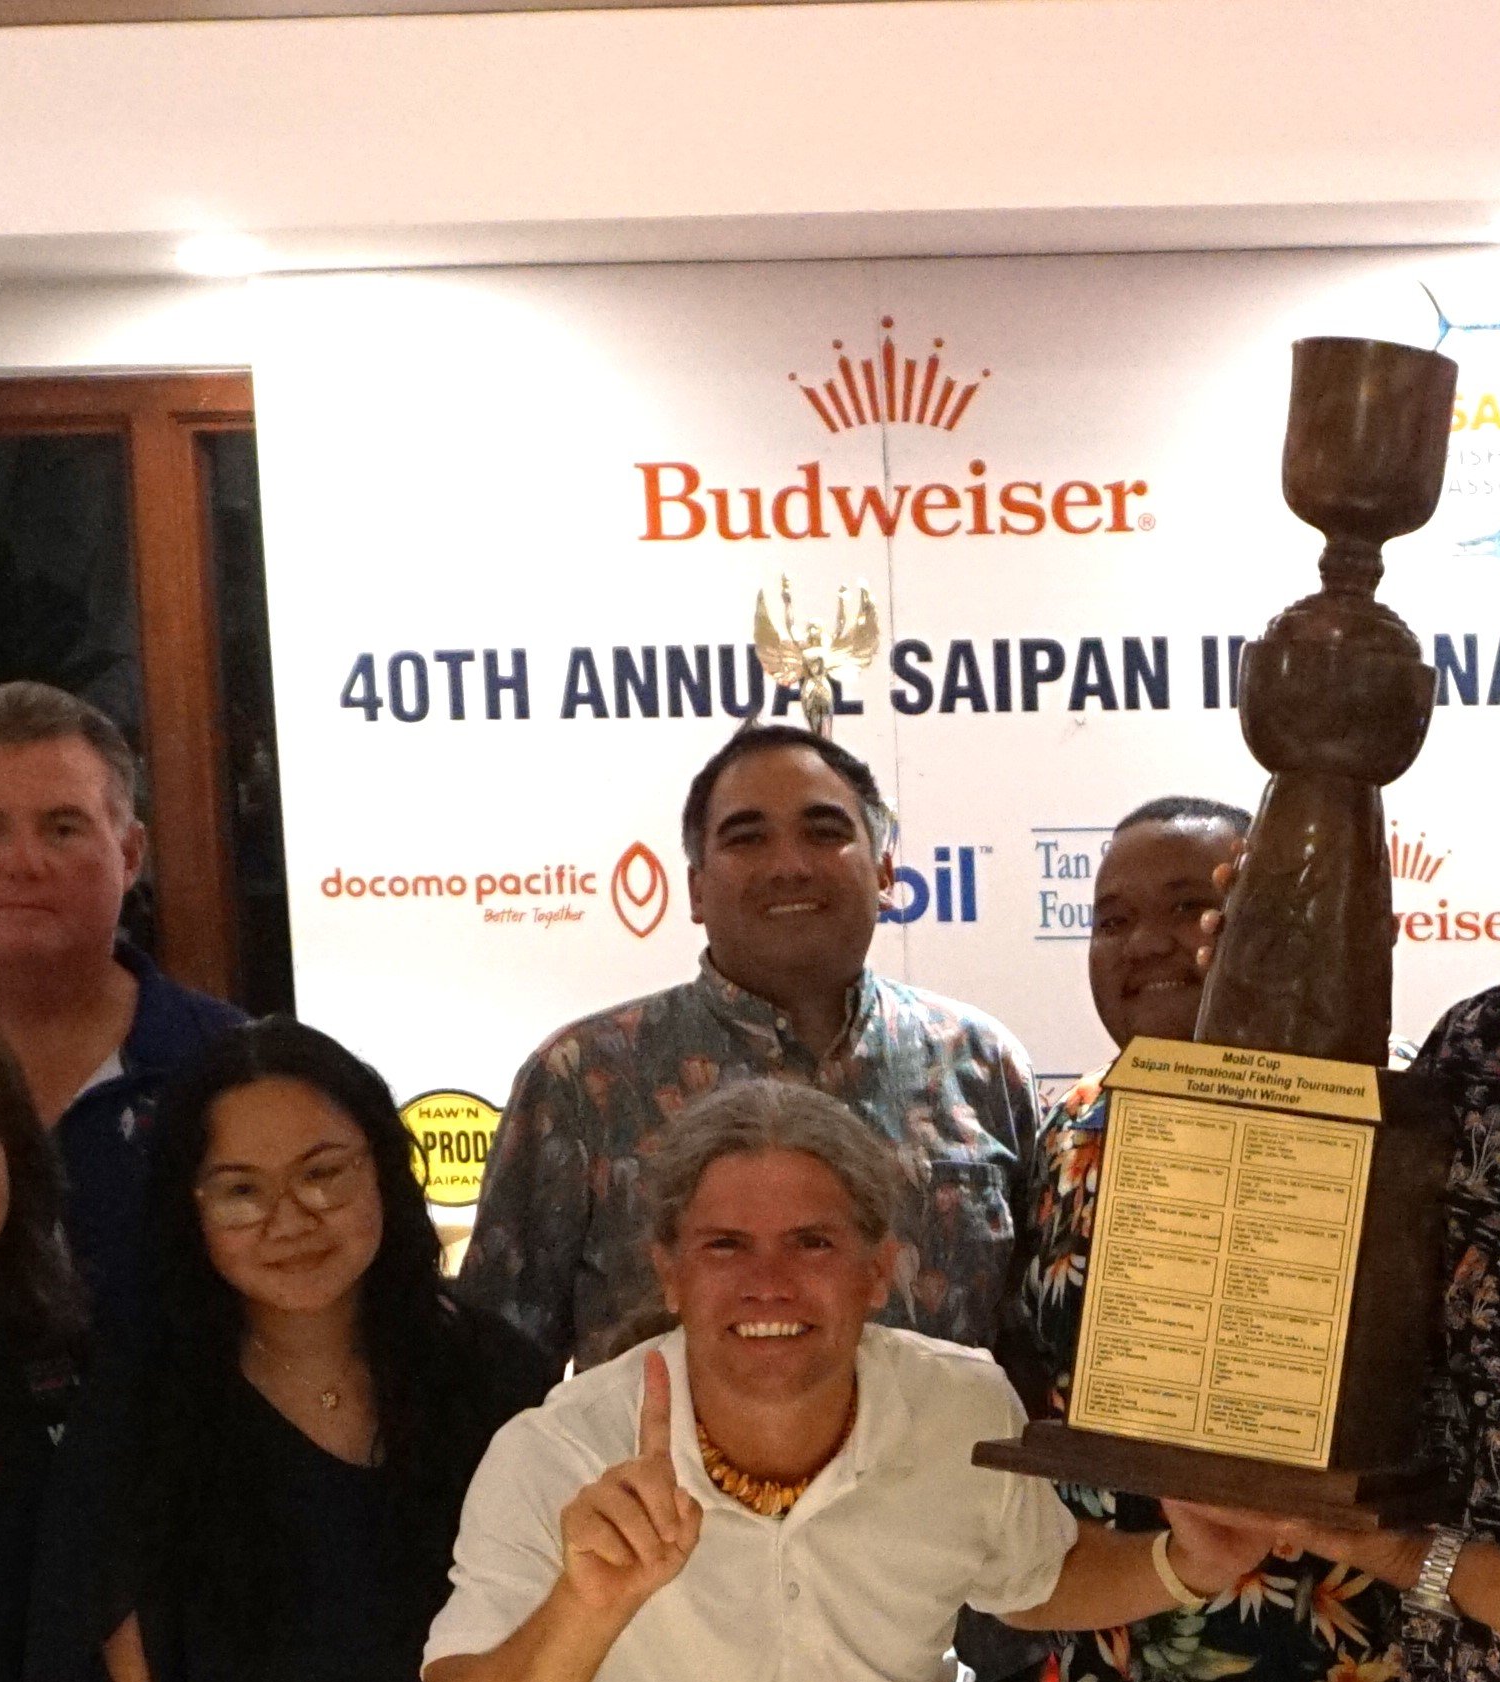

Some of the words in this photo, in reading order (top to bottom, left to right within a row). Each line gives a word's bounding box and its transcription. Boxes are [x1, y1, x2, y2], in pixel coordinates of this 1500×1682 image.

[635, 459, 1148, 542] Budweiser
[340, 649, 530, 723] 40TH
[891, 637, 1187, 714] SAIPAN
[1035, 840, 1092, 881] Tan
[321, 867, 467, 898] docomo
[476, 865, 598, 904] pacific
[876, 846, 978, 924] bil
[484, 908, 527, 924] Better
[533, 906, 586, 928] Together
[1131, 1056, 1171, 1074] Saipan
[1173, 1062, 1247, 1082] International
[1249, 1071, 1293, 1090] Fishing
[1296, 1076, 1367, 1097] Tournament
[1221, 1051, 1254, 1067] Mobil
[1257, 1055, 1281, 1070] Cup
[1186, 1079, 1214, 1093] Total
[1217, 1083, 1259, 1101] Weight
[1260, 1089, 1302, 1104] Winner
[418, 1107, 480, 1120] HAW'N
[423, 1130, 495, 1164] PROD
